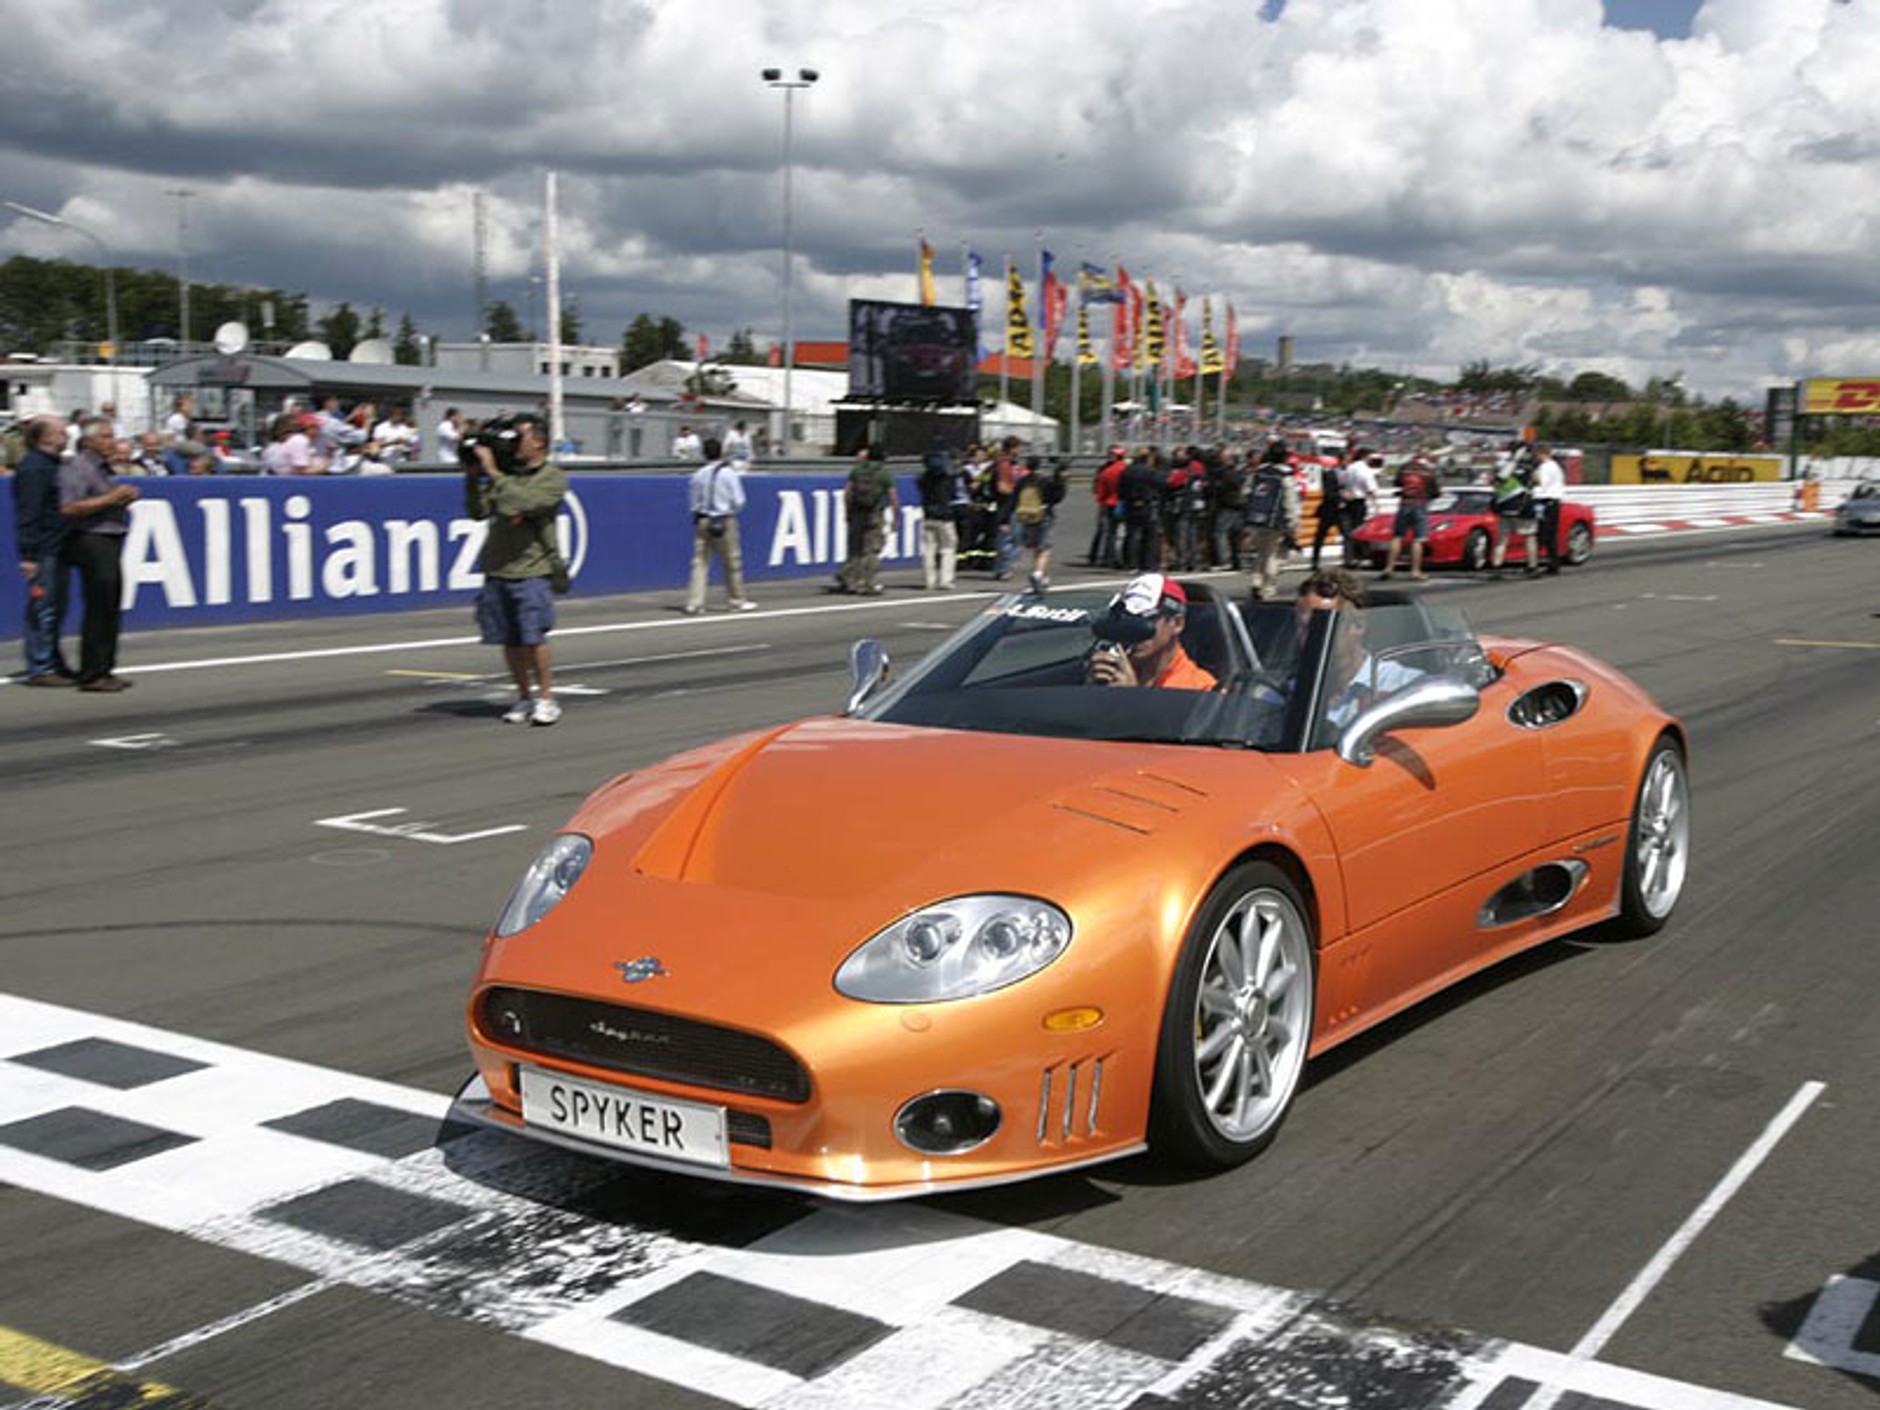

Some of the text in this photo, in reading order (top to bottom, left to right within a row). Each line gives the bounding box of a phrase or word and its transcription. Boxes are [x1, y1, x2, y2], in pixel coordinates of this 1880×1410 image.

[120, 496, 490, 611] Allianz
[767, 489, 925, 567] Allan
[551, 1085, 684, 1150] SPYKER
